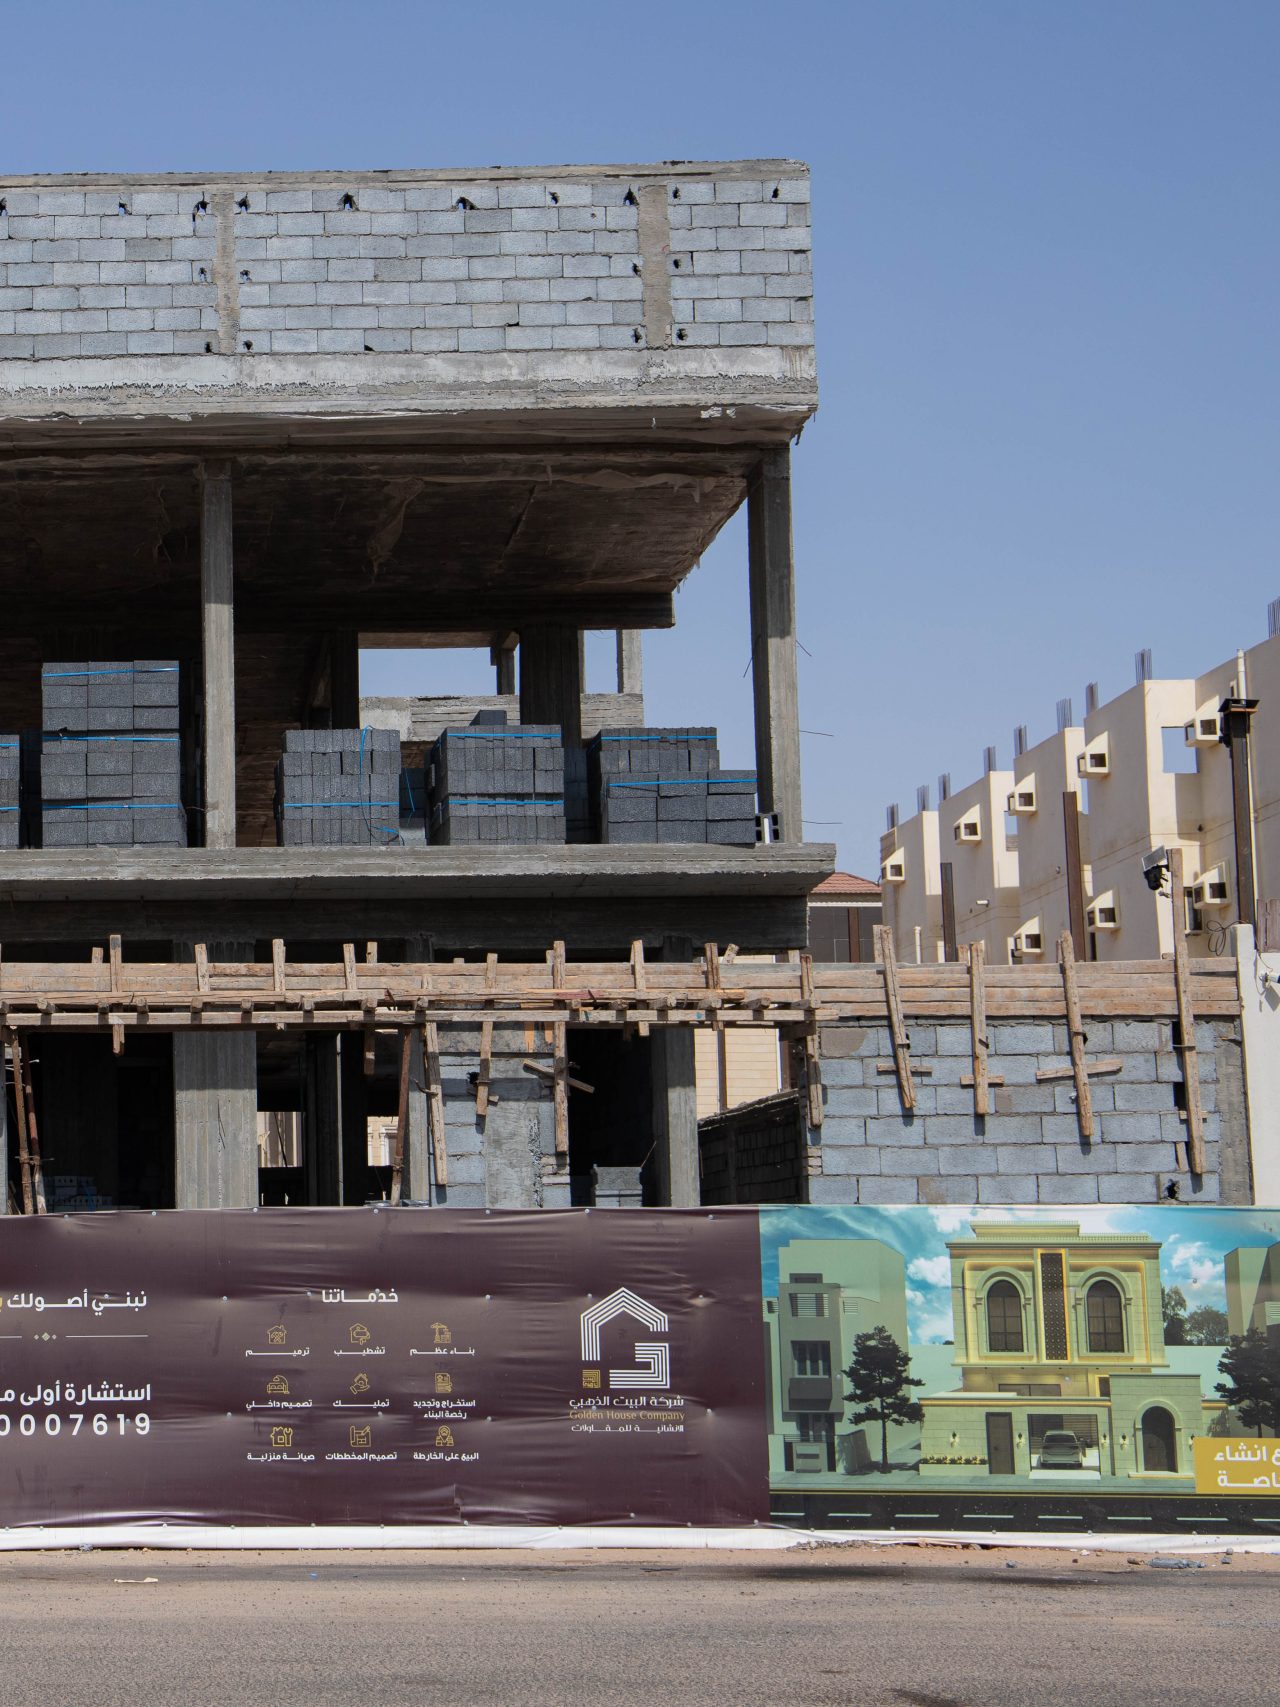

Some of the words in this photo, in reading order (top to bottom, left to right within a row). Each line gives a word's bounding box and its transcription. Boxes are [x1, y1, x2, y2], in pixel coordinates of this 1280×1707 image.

[7, 1288, 89, 1311] أصولك
[321, 1288, 399, 1303] خدماتنا
[91, 1290, 147, 1316] نبني
[245, 1346, 310, 1357] ترميم
[333, 1346, 386, 1357] تشطيب
[409, 1346, 448, 1357] عظم
[449, 1346, 475, 1357] بناء
[20, 1380, 61, 1406] أولى
[65, 1381, 151, 1406] استشارة
[245, 1399, 281, 1411] داخلي
[281, 1399, 313, 1409] تصميم
[332, 1399, 390, 1409] تمليك
[413, 1399, 441, 1409] وتجديد
[441, 1399, 476, 1409] استخراج
[569, 1396, 610, 1409] الذهبي
[613, 1396, 647, 1409] البيت
[649, 1394, 685, 1409] شركة
[423, 1410, 444, 1419] البناء
[444, 1409, 467, 1420] رخصة
[569, 1410, 603, 1420] Golden
[606, 1410, 637, 1420] House
[639, 1410, 685, 1422] Company
[247, 1451, 282, 1462] منزلية
[282, 1451, 316, 1461] صيانة
[325, 1451, 369, 1461] المخططات
[369, 1451, 398, 1462] تصميم
[413, 1451, 444, 1461] الخارطة
[444, 1451, 460, 1461] على
[461, 1451, 479, 1462] البيع
[1214, 1442, 1268, 1461] انشاء
[1217, 1470, 1280, 1488] اصة
